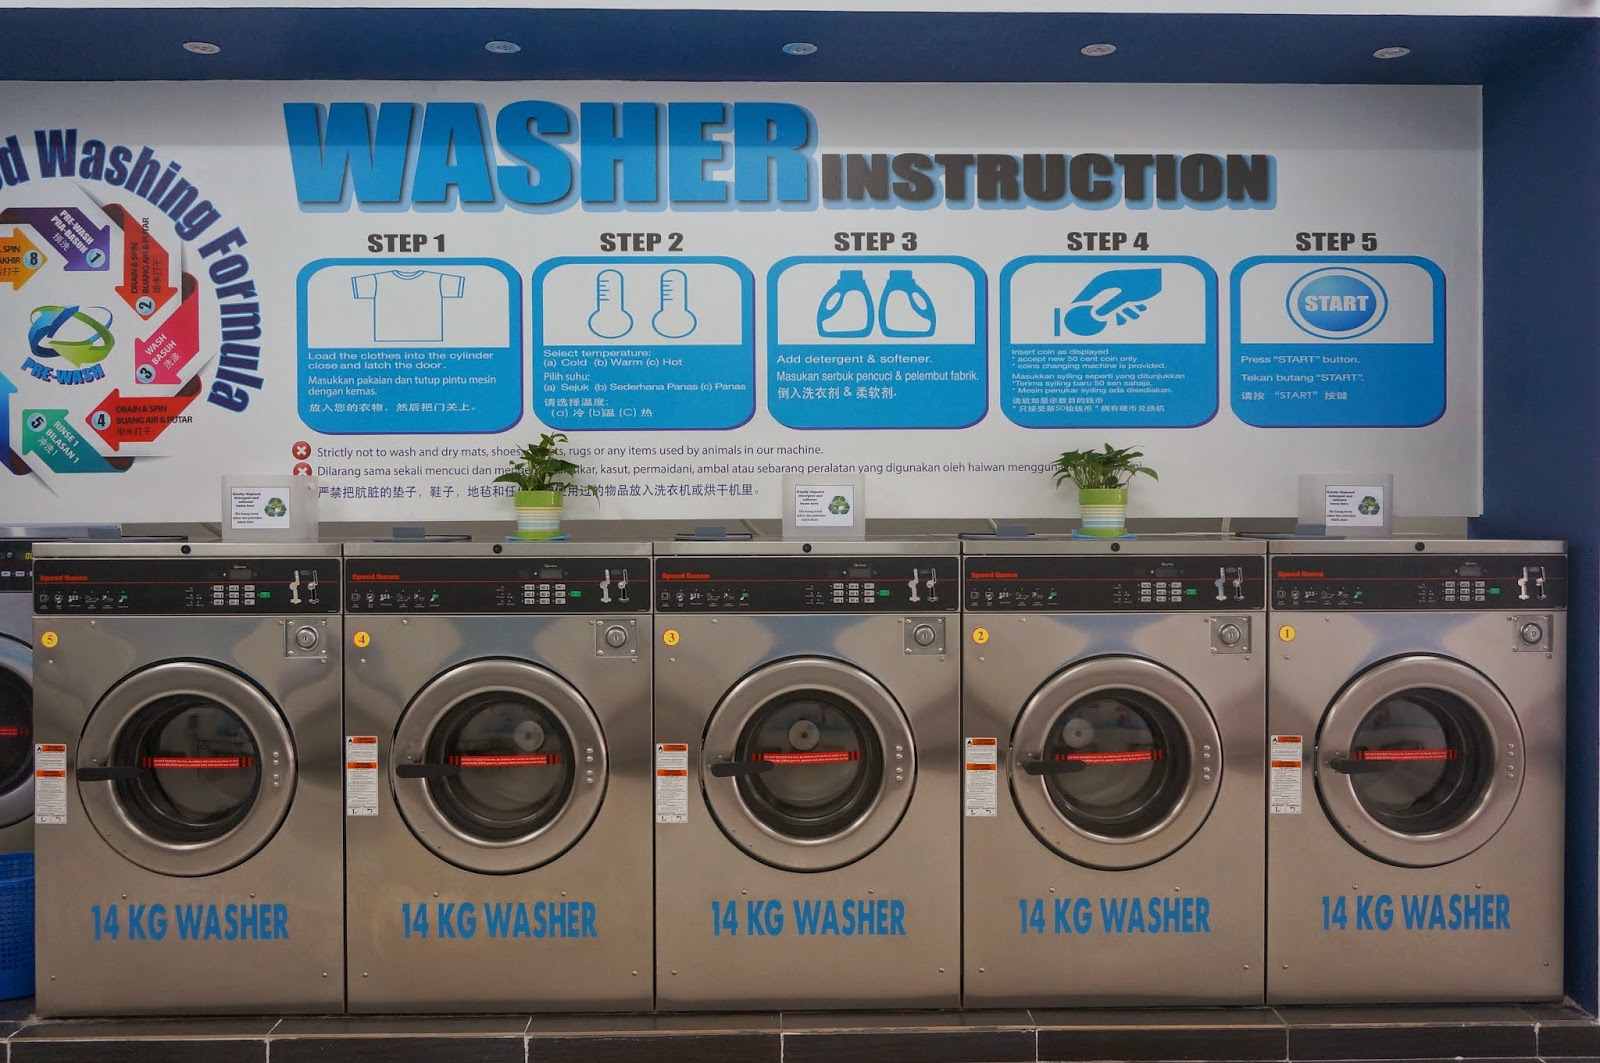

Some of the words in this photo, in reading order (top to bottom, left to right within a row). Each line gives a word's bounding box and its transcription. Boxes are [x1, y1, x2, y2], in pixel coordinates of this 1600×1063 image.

[284, 100, 816, 208] WASHER
[822, 153, 1274, 206] INSTRUCTION
[50, 215, 88, 253] PRA-BASUH
[59, 209, 94, 245] PRE-WASH
[368, 234, 427, 252] STEP
[434, 234, 444, 252] 1
[600, 233, 661, 252] STEP
[668, 233, 683, 251] 2
[834, 232, 895, 251] STEP
[902, 232, 917, 251] 3
[1067, 232, 1127, 251] STEP
[1133, 232, 1149, 251] 4
[1296, 232, 1355, 251] STEP
[1362, 233, 1377, 251] 5
[30, 252, 38, 265] 8
[90, 252, 101, 263] 1
[34, 128, 221, 241] Washing
[197, 225, 264, 412] Formula
[138, 302, 152, 310] 2
[1305, 295, 1368, 311] START
[145, 334, 168, 356] WASH
[1068, 348, 1108, 356] displayed
[151, 340, 177, 365] BASUH
[308, 352, 336, 360] Load
[338, 352, 358, 360] the
[360, 352, 402, 360] clothes
[404, 352, 426, 360] into
[428, 352, 446, 360] the
[450, 352, 494, 360] cylinder
[544, 350, 578, 358] Select
[582, 350, 652, 358] temperature:
[308, 362, 338, 370] close
[340, 362, 362, 370] and
[364, 362, 392, 370] latch
[394, 362, 412, 370] the
[560, 358, 588, 366] Cold
[610, 358, 642, 366] Warm
[776, 354, 800, 364] Add
[804, 354, 864, 366] detergent
[880, 354, 932, 364] softener.
[1240, 356, 1272, 364] Press
[1322, 356, 1360, 364] button.
[20, 356, 106, 385] PRE-WASH
[140, 368, 152, 379] 3
[544, 372, 564, 380] Pilih
[564, 372, 590, 380] suhu:
[776, 370, 820, 382] Masukan
[822, 370, 854, 382] serbuk
[856, 370, 892, 384] pencuci
[904, 370, 948, 382] pelembut
[950, 370, 980, 380] fabrik.
[1136, 372, 1186, 380] ditunjukkan
[308, 376, 354, 384] Masukkan
[356, 376, 392, 386] pakaian
[394, 376, 412, 384] dan
[414, 376, 440, 386] tutup
[442, 376, 466, 386] pintu
[468, 376, 496, 384] mesin
[1240, 374, 1274, 382] Tekan
[1276, 374, 1314, 384] butang
[308, 386, 344, 398] dengan
[346, 386, 378, 396] kemas.
[31, 416, 44, 428] 5
[98, 414, 106, 426] 4
[53, 420, 76, 443] RINSE
[46, 428, 75, 460] BILASAN
[318, 448, 353, 459] Strictly
[356, 449, 373, 457] not
[390, 447, 416, 456] wash
[419, 447, 438, 456] and
[442, 447, 458, 458] dry
[462, 448, 488, 457] mats,
[569, 448, 591, 458] rugs
[608, 448, 625, 457] any
[629, 446, 656, 455] items
[660, 445, 683, 454] used
[687, 445, 699, 457] by
[702, 445, 741, 454] animals
[745, 446, 753, 454] in
[777, 445, 823, 454] machine.
[318, 466, 360, 478] Dilarang
[394, 466, 422, 475] sekali
[426, 466, 469, 475] mencuci
[472, 465, 491, 475] dan
[601, 464, 630, 475] kasut,
[634, 464, 694, 476] permaidani,
[698, 464, 728, 473] ambal
[732, 465, 754, 473] atau
[758, 464, 804, 474] sebarang
[808, 463, 855, 474] peralatan
[858, 465, 882, 474] yang
[886, 463, 940, 474] digunakan
[943, 463, 965, 472] oleh
[969, 462, 1004, 471] haiwan
[712, 901, 738, 936] 14
[748, 899, 784, 936] KG
[794, 899, 906, 936] WASHER
[1019, 899, 1045, 934] 14
[1055, 898, 1092, 934] KG
[1100, 897, 1210, 933] WASHER
[1322, 896, 1347, 930] 14
[1357, 895, 1393, 931] KG
[1402, 894, 1510, 930] WASHER
[91, 905, 119, 940] 14
[123, 903, 167, 941] KG
[175, 904, 289, 940] WASHER
[402, 903, 428, 938] 14
[439, 902, 476, 939] KG
[484, 902, 597, 938] WASHER
